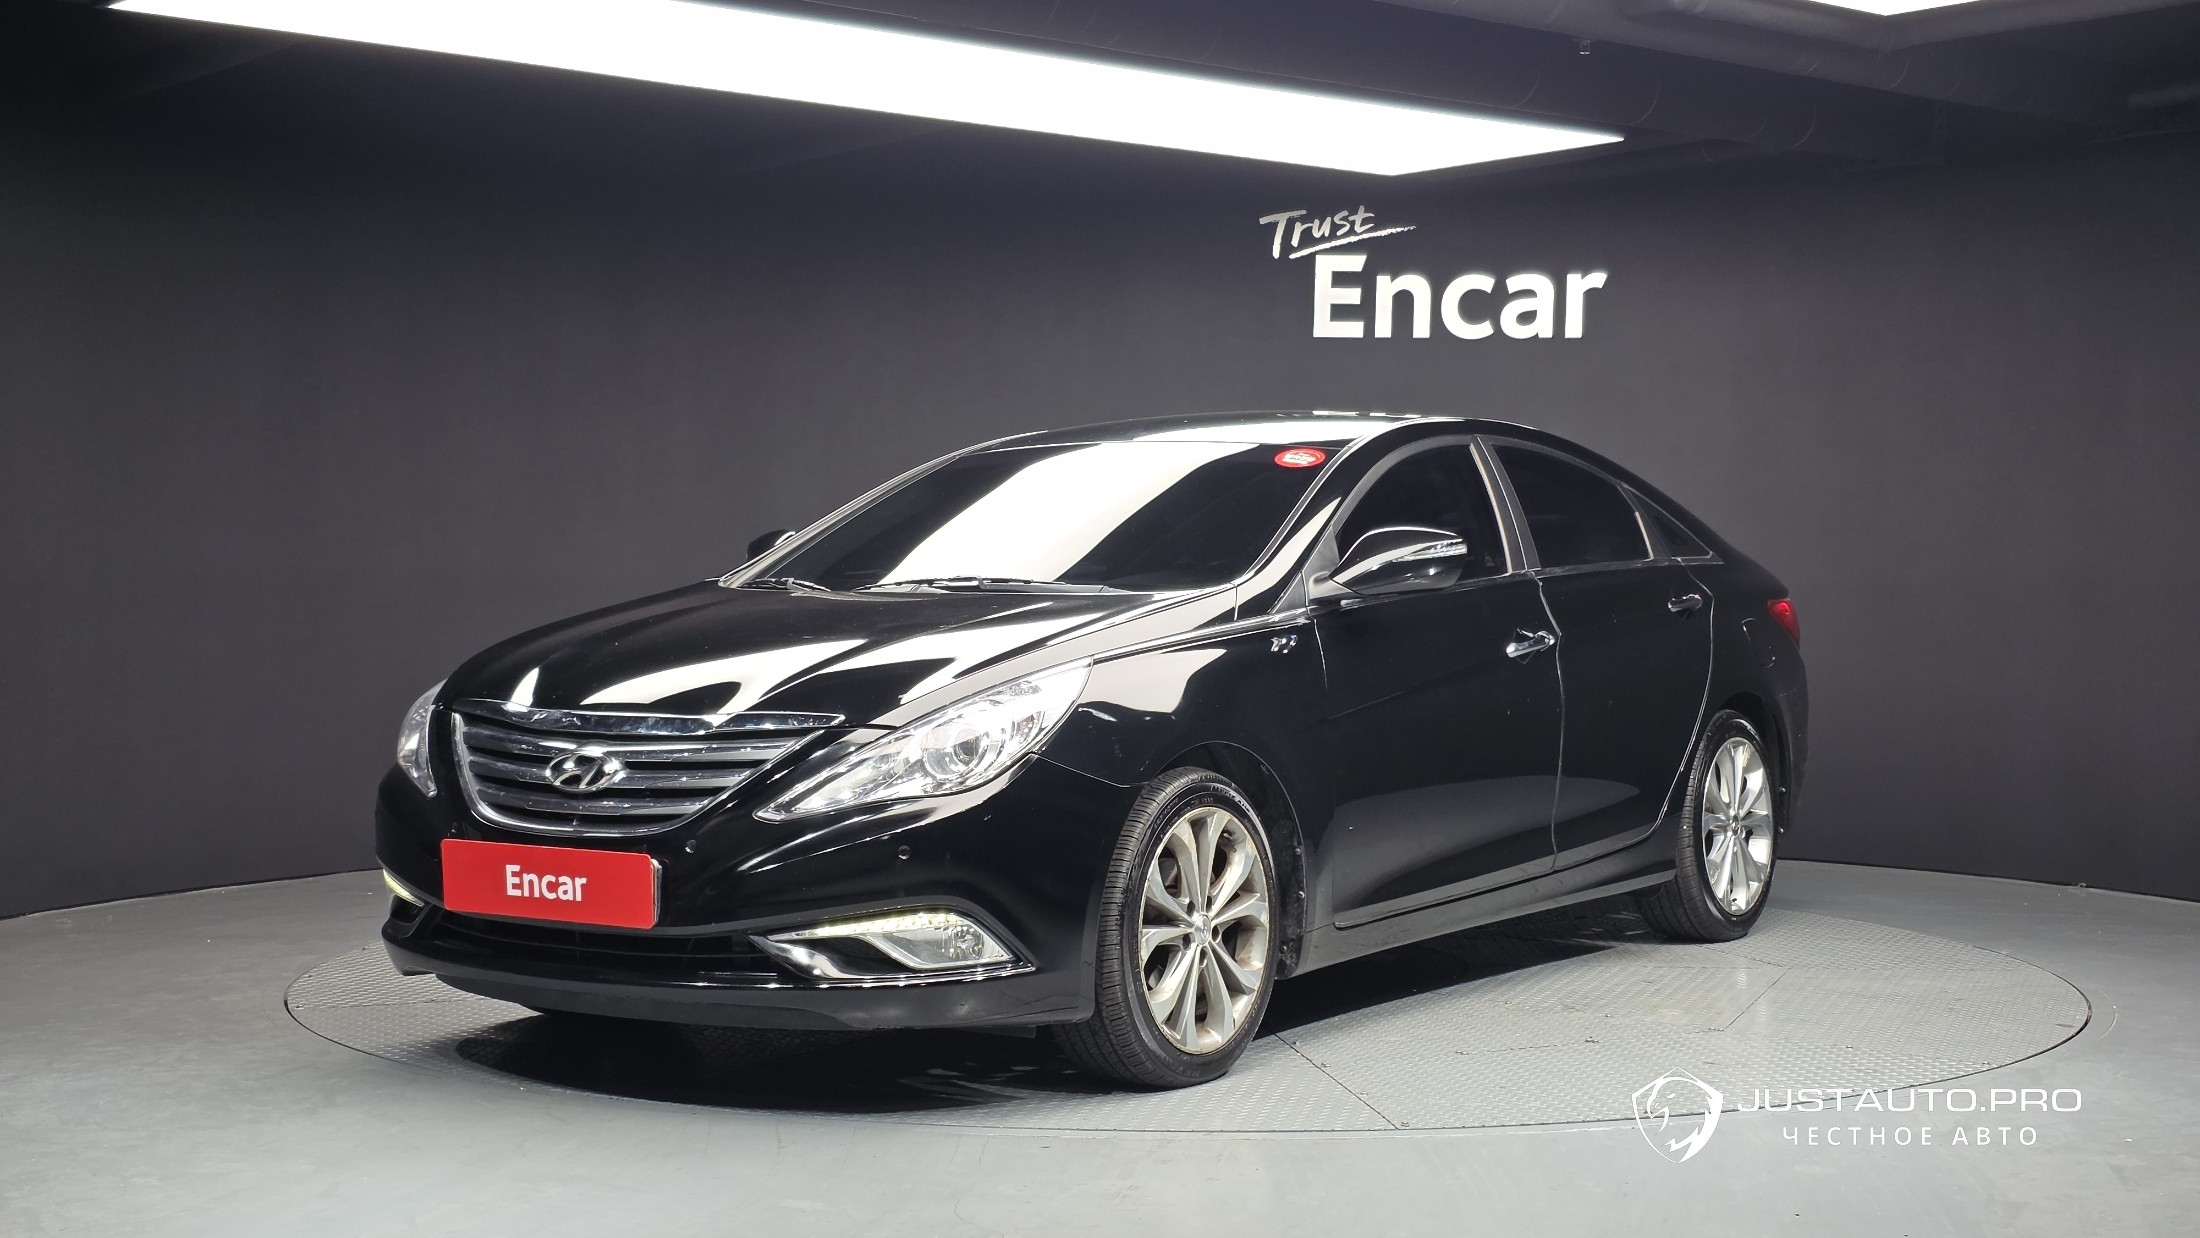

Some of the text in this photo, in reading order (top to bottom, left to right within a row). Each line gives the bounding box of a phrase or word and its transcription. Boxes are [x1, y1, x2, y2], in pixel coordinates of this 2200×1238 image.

[1259, 205, 1376, 260] Trust
[1312, 254, 1608, 340] Encar
[505, 864, 588, 902] Encar
